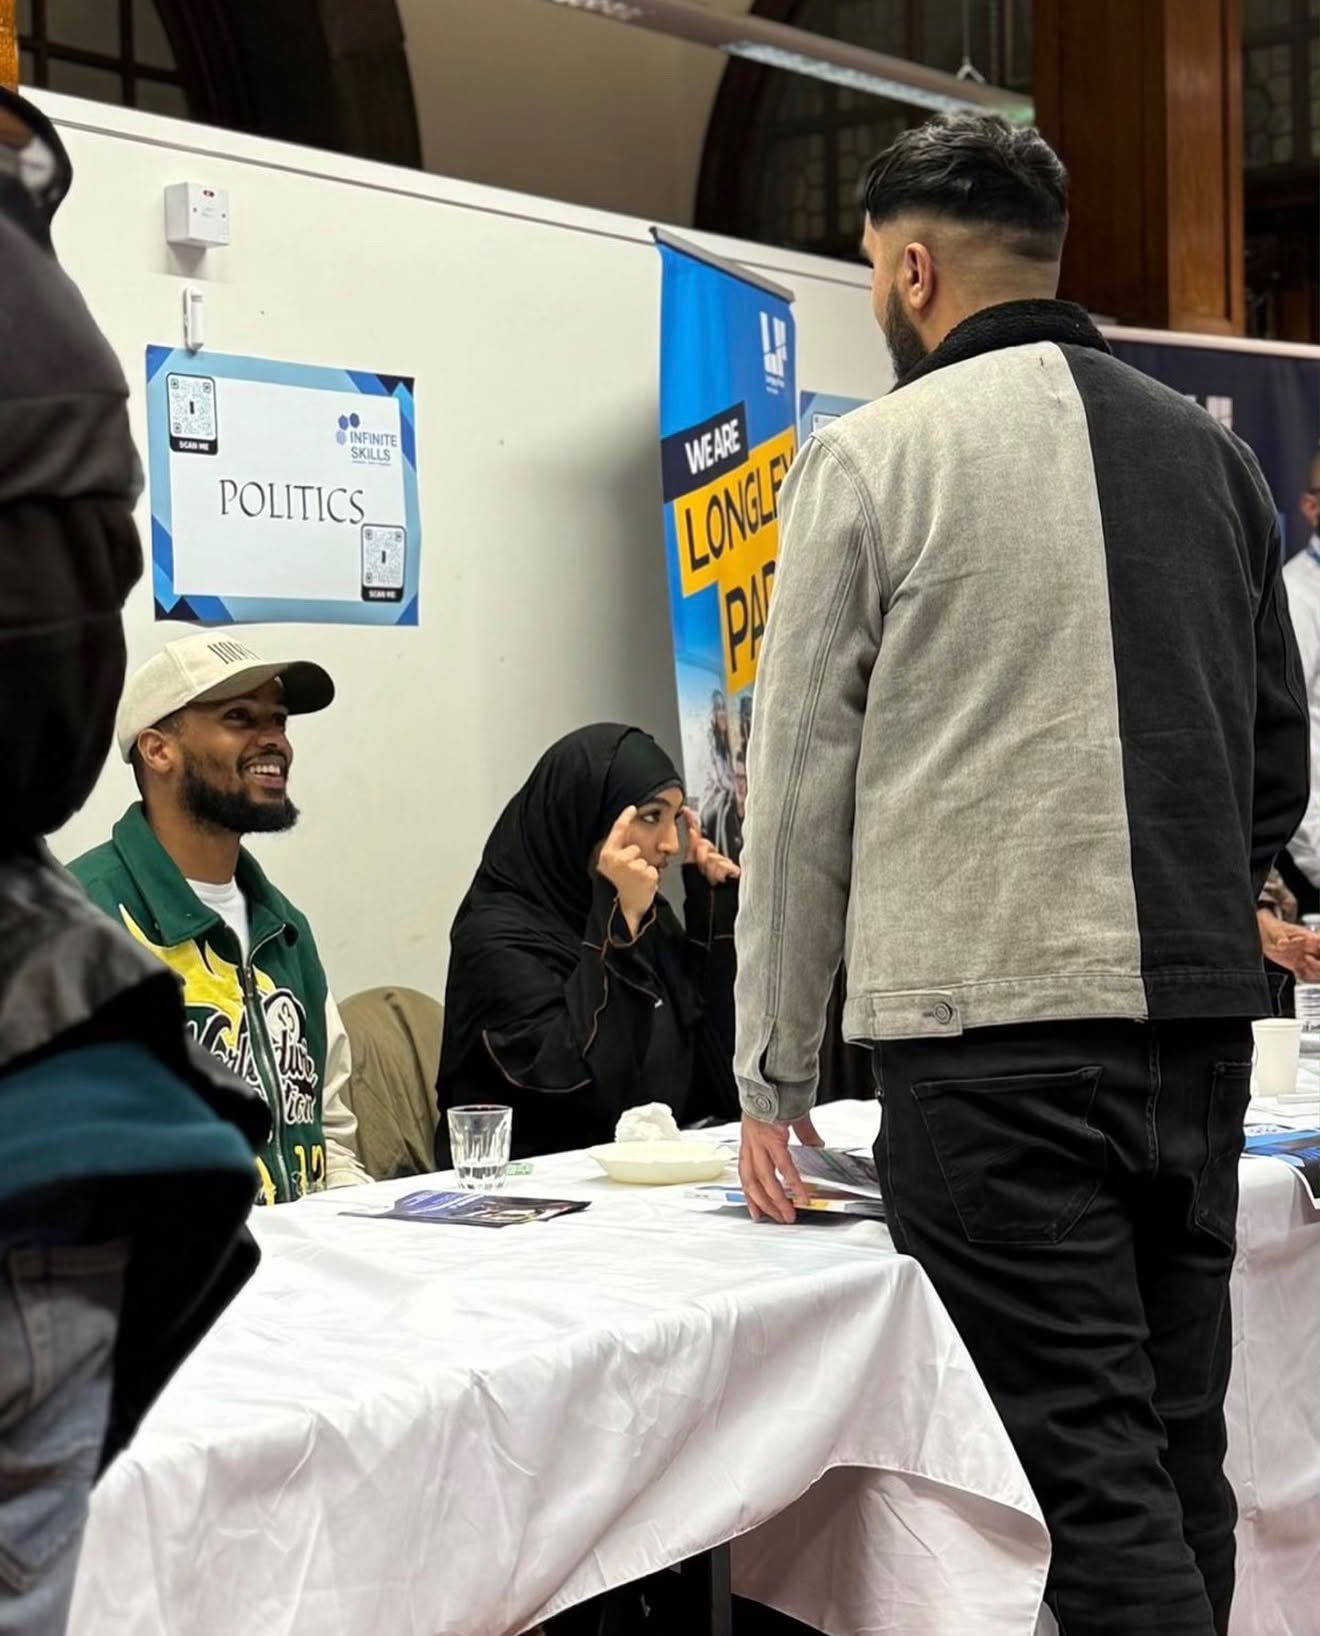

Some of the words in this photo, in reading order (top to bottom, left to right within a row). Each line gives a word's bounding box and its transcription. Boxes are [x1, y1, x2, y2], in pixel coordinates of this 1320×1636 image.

[179, 440, 198, 450] SCAN
[199, 443, 209, 451] ME
[350, 431, 398, 447] INFINITE
[351, 446, 391, 462] SKILLS
[219, 479, 365, 524] POLITICS
[369, 590, 385, 599] SCAN
